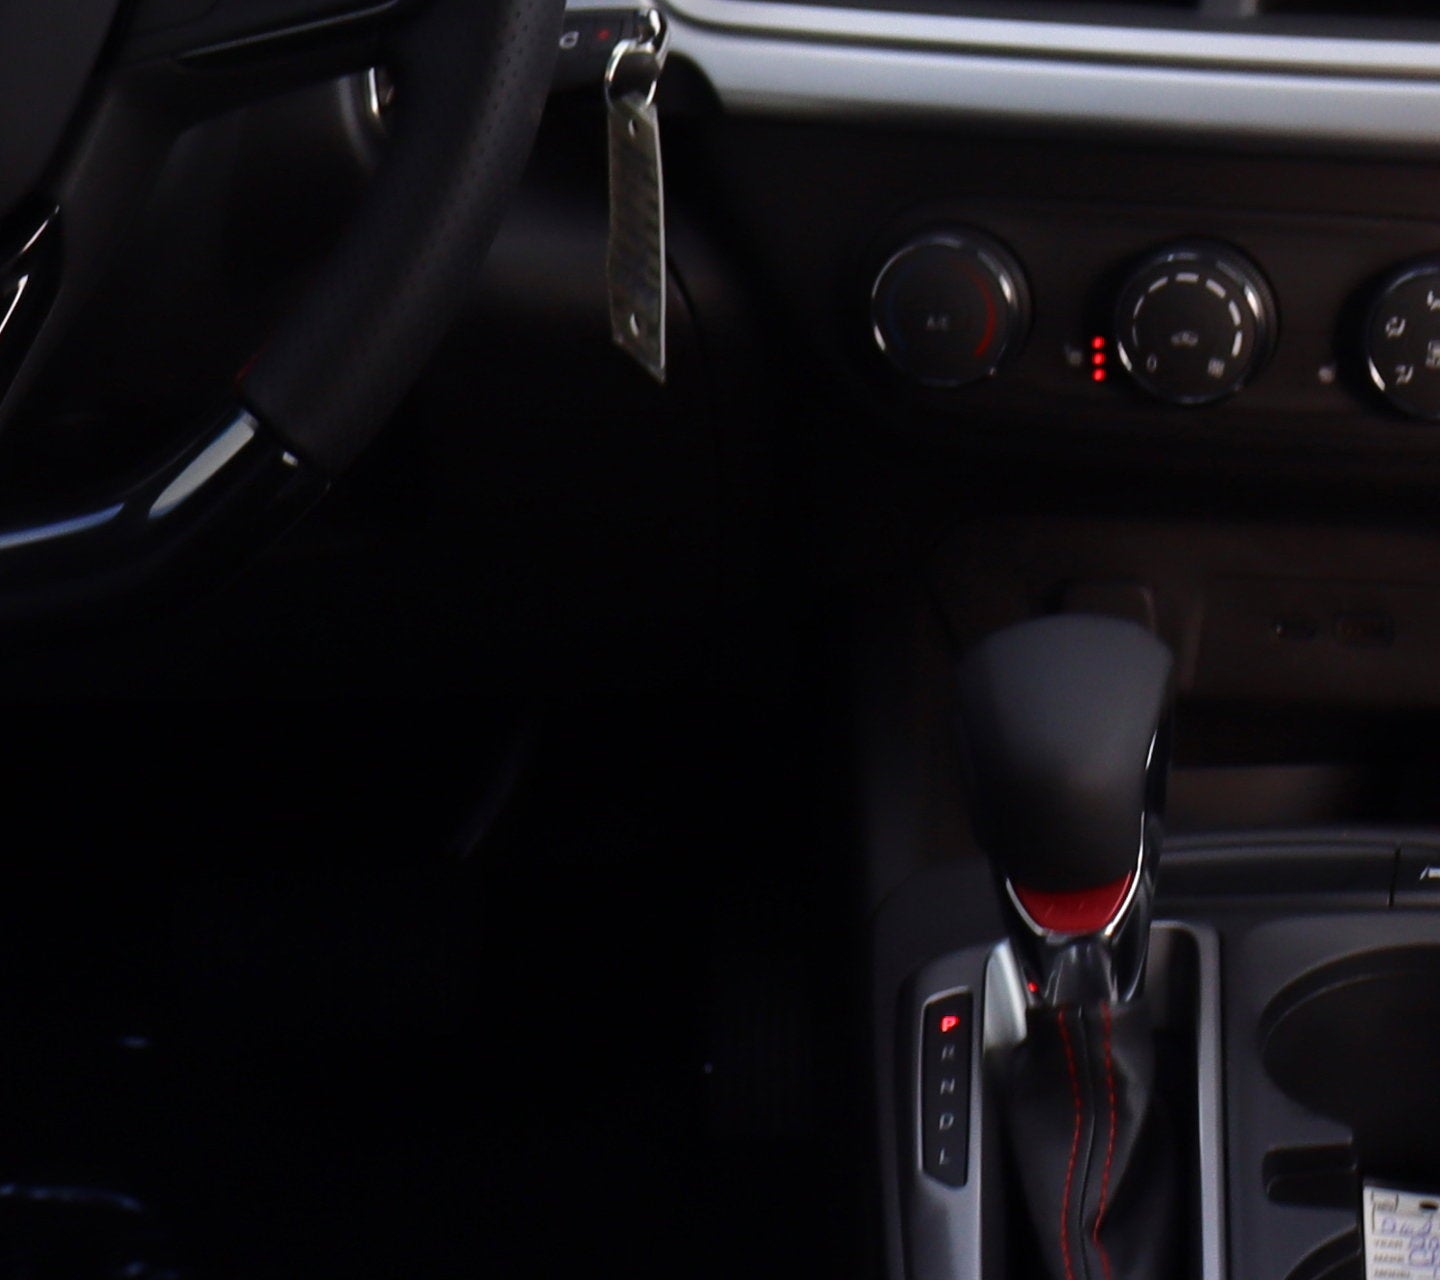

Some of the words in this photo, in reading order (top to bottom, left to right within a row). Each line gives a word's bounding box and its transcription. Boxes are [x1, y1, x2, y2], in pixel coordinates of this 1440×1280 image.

[941, 1014, 961, 1033] P
[940, 1077, 956, 1096] N
[938, 1111, 955, 1130] D
